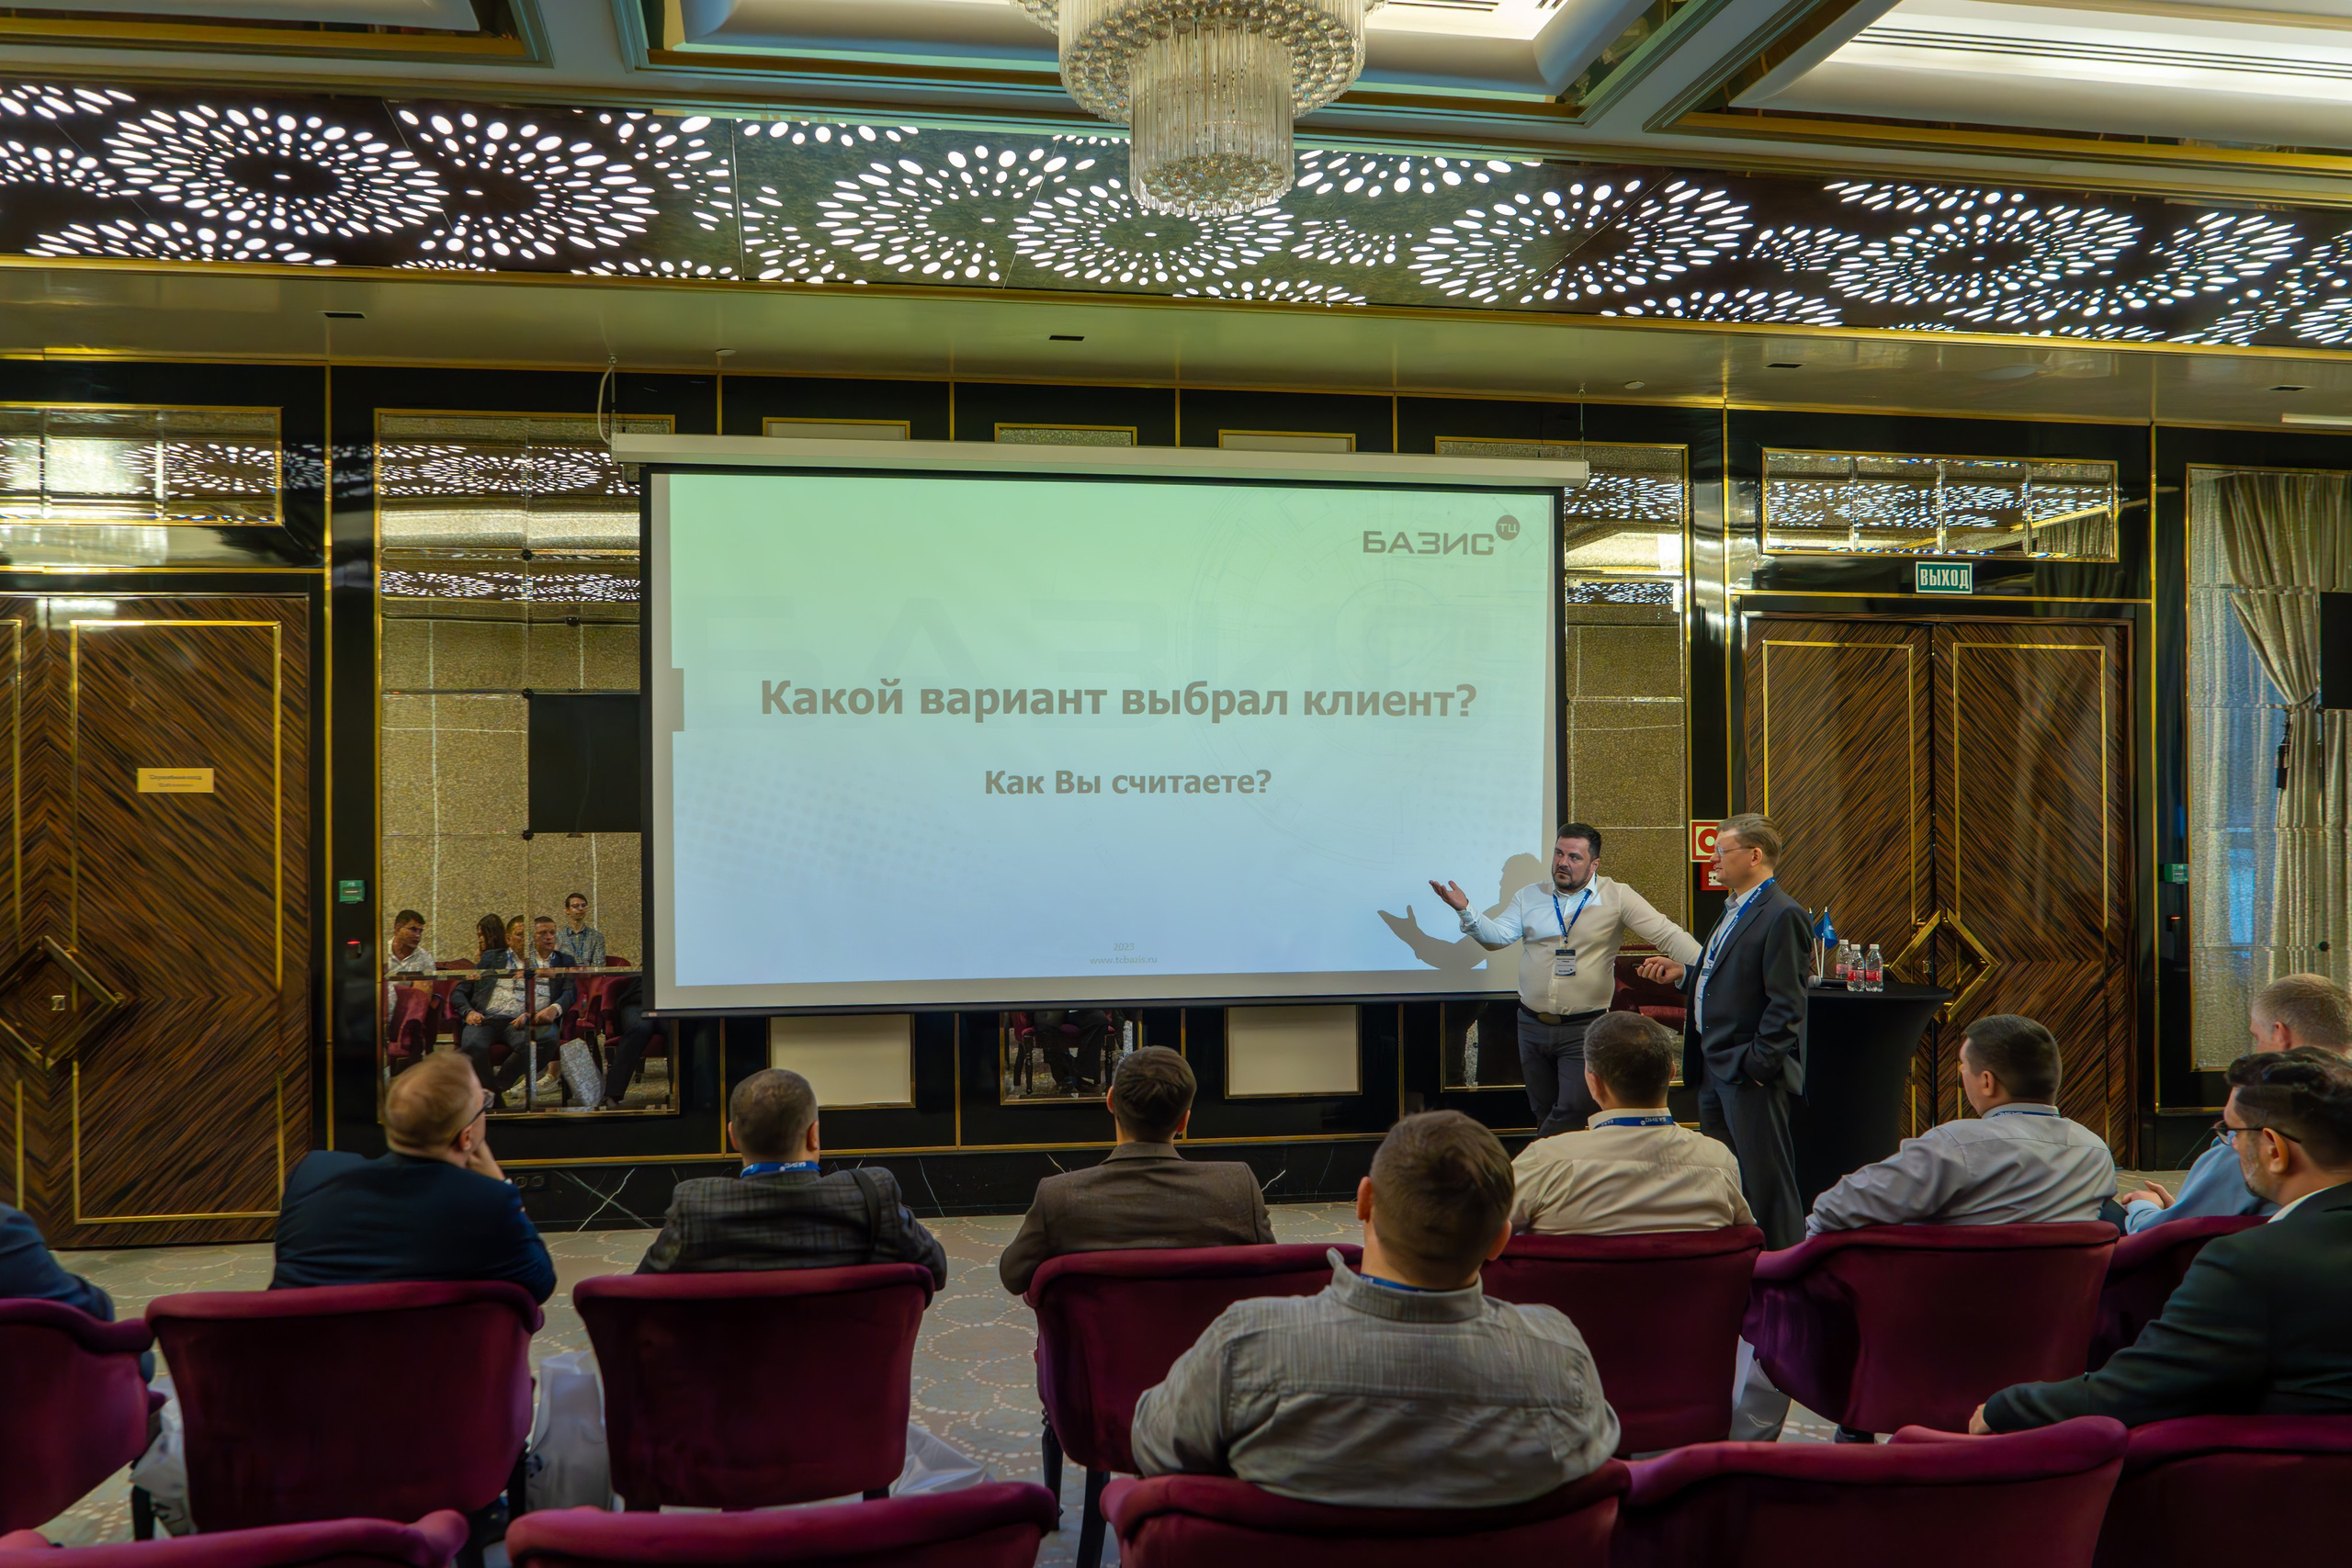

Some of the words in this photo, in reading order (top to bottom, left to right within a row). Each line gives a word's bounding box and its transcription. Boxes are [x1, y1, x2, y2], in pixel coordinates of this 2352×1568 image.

[1498, 523, 1518, 534] ТЦ
[1363, 529, 1495, 556] БАЗИС
[1919, 569, 1970, 590] ВЫХОД
[762, 678, 903, 716] Какой
[920, 687, 1108, 724] вариант
[1122, 681, 1288, 724] выбрал
[1304, 683, 1477, 717] клиент?
[985, 771, 1046, 795] Как
[1055, 771, 1102, 795] Вы
[1111, 769, 1272, 795] считаете?
[1113, 942, 1136, 952] 2023
[1089, 955, 1159, 965] www.tcbazis.ru
